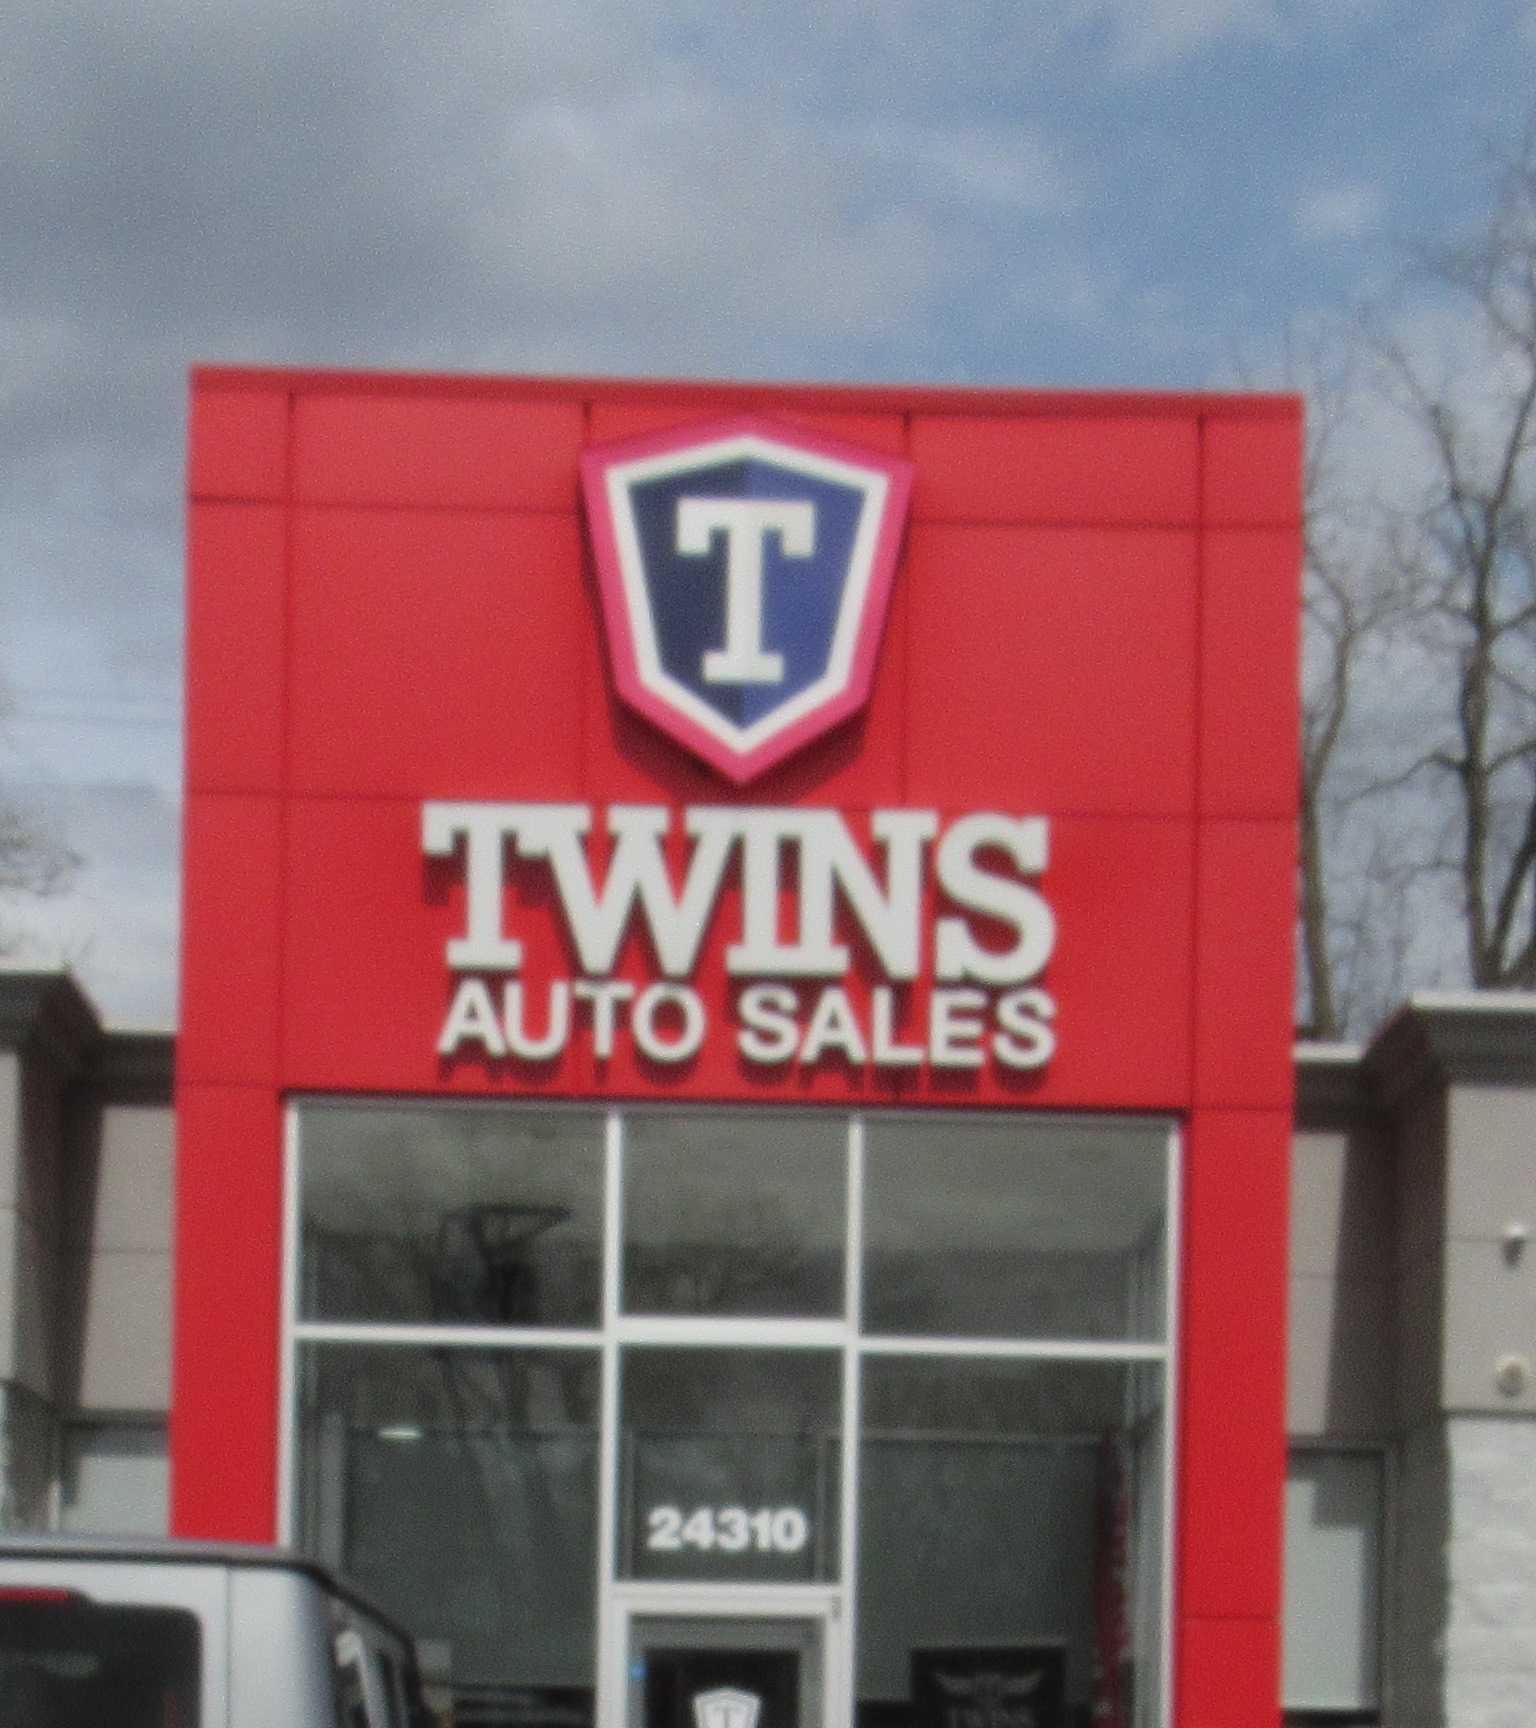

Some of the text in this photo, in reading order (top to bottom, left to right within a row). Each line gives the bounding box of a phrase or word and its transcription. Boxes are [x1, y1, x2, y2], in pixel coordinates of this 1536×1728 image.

[675, 498, 816, 684] T
[421, 802, 1056, 985] TWINS
[437, 977, 1057, 1070] AUTO SALES
[646, 1504, 809, 1552] 24310
